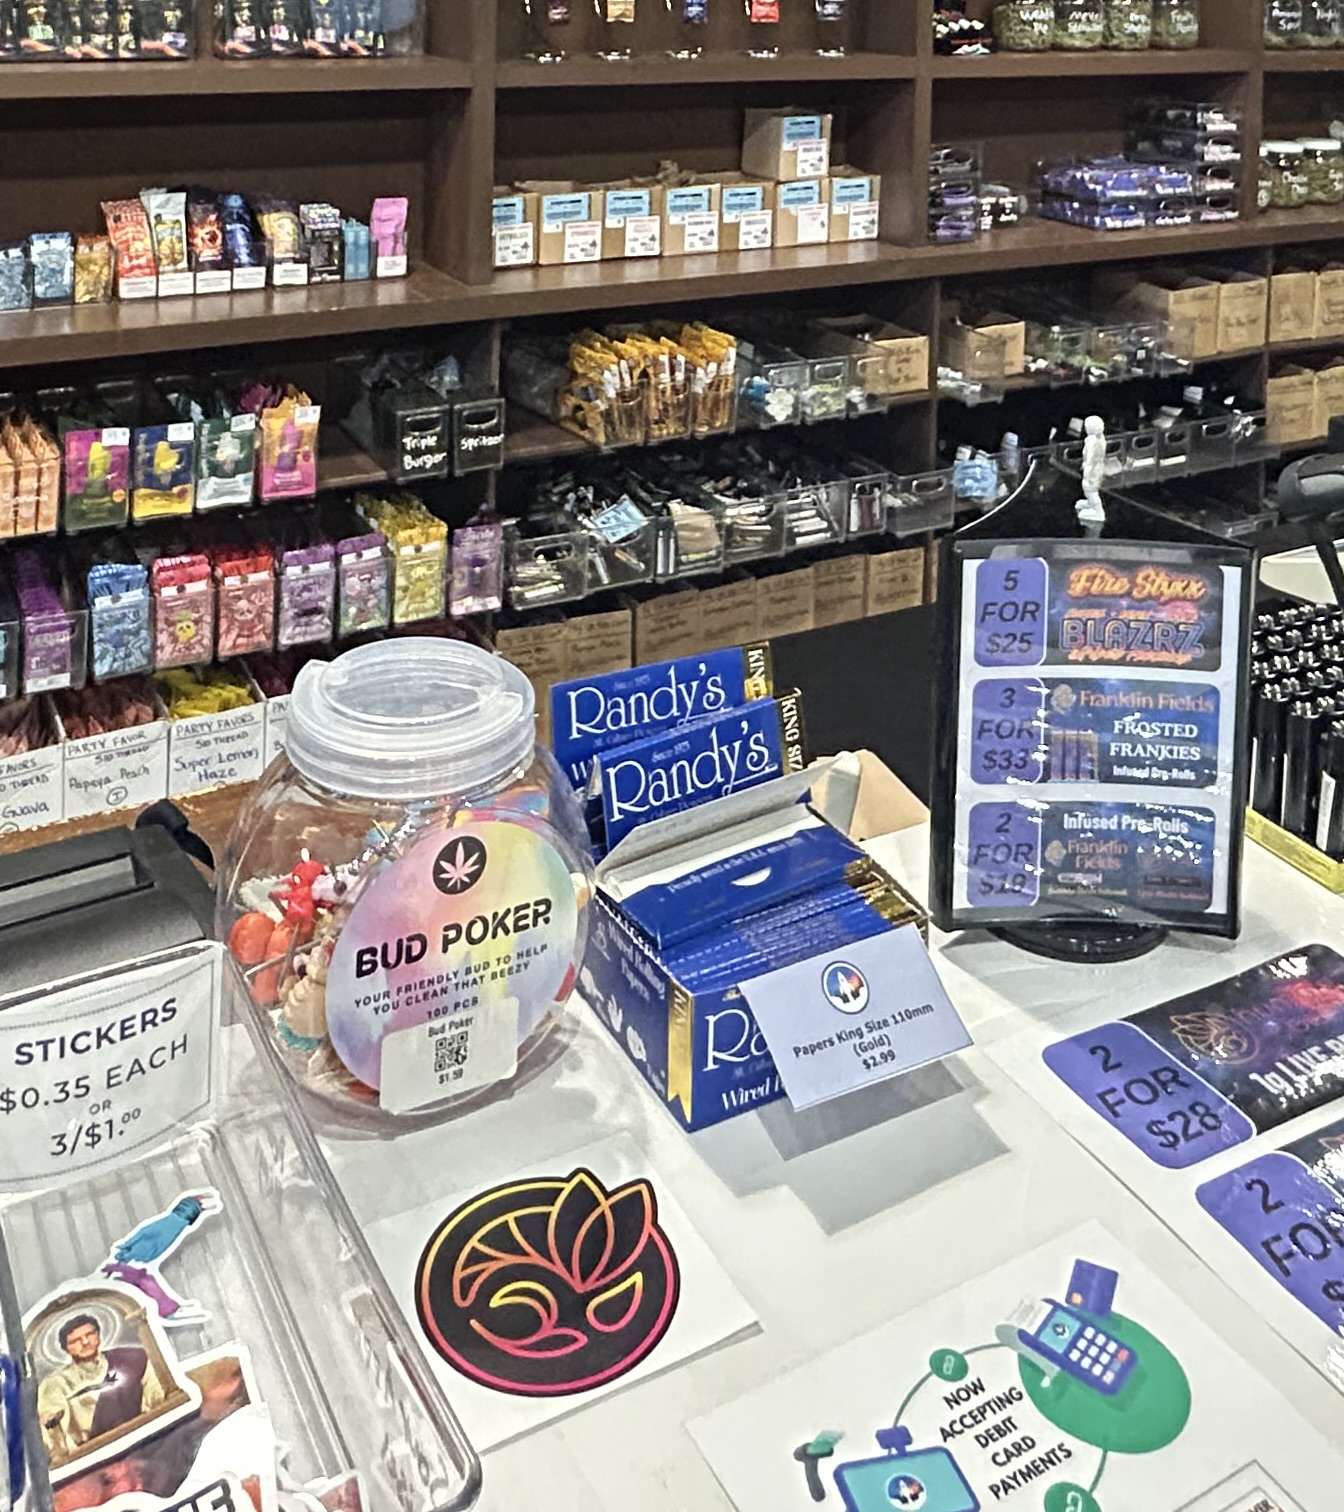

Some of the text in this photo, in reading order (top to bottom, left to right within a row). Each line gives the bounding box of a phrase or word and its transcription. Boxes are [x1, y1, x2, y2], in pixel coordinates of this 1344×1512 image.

[402, 435, 437, 450] Triple
[460, 433, 504, 451] Spritzer
[403, 452, 447, 470] Burger
[1002, 569, 1020, 591] 5
[980, 601, 1041, 624] FOR
[985, 632, 1036, 656] $25
[1059, 617, 1206, 657] BLAZRZ
[567, 661, 735, 740] Randy's
[999, 687, 1017, 709] 3
[1080, 691, 1216, 713] Franklin Fields
[176, 711, 256, 738] PARTY FAVORS
[781, 698, 801, 741] KING
[976, 718, 1038, 741] FOR
[1113, 719, 1199, 739] FROSTED
[67, 730, 146, 756] PARTY FAVOR
[1109, 742, 1202, 762] FRANKIES
[173, 755, 212, 774] Super
[606, 720, 778, 823] Randy's
[982, 749, 1031, 772] $33
[11, 772, 50, 789] THREAD
[68, 765, 151, 793] Papaya Peach
[197, 766, 237, 783] Haze
[1, 801, 50, 819] Guava
[995, 812, 1014, 834] 2
[1063, 813, 1189, 834] Infused Pre-Rolls
[972, 842, 1035, 867] FOR
[355, 898, 553, 979] BUD POKER
[354, 943, 548, 1009] YOUR FRIENDLY BUD TO HELP
[373, 961, 531, 1016] YOU CLEAN THAT BEEZY
[427, 996, 479, 1020] 100 PCS
[14, 997, 178, 1066] STICKERS
[428, 1015, 474, 1039] Bud Poker
[792, 1003, 935, 1059] Papers King Size 110mm
[852, 1034, 892, 1059] (Gold)
[1089, 1045, 1123, 1073] 2
[861, 1049, 897, 1072] $2.99
[0, 1033, 189, 1116] $0.35 EACH
[721, 1078, 771, 1111] Wired
[1096, 1066, 1191, 1119] FOR
[89, 1099, 112, 1116] OR
[1146, 1101, 1224, 1151] $28
[1245, 1178, 1286, 1215] 2
[942, 1377, 987, 1412] NOW
[938, 1385, 1025, 1443] ACCEPTING
[974, 1416, 1020, 1451] DEBIT
[990, 1434, 1038, 1469] CARD
[988, 1442, 1074, 1501] PAYMENTS
